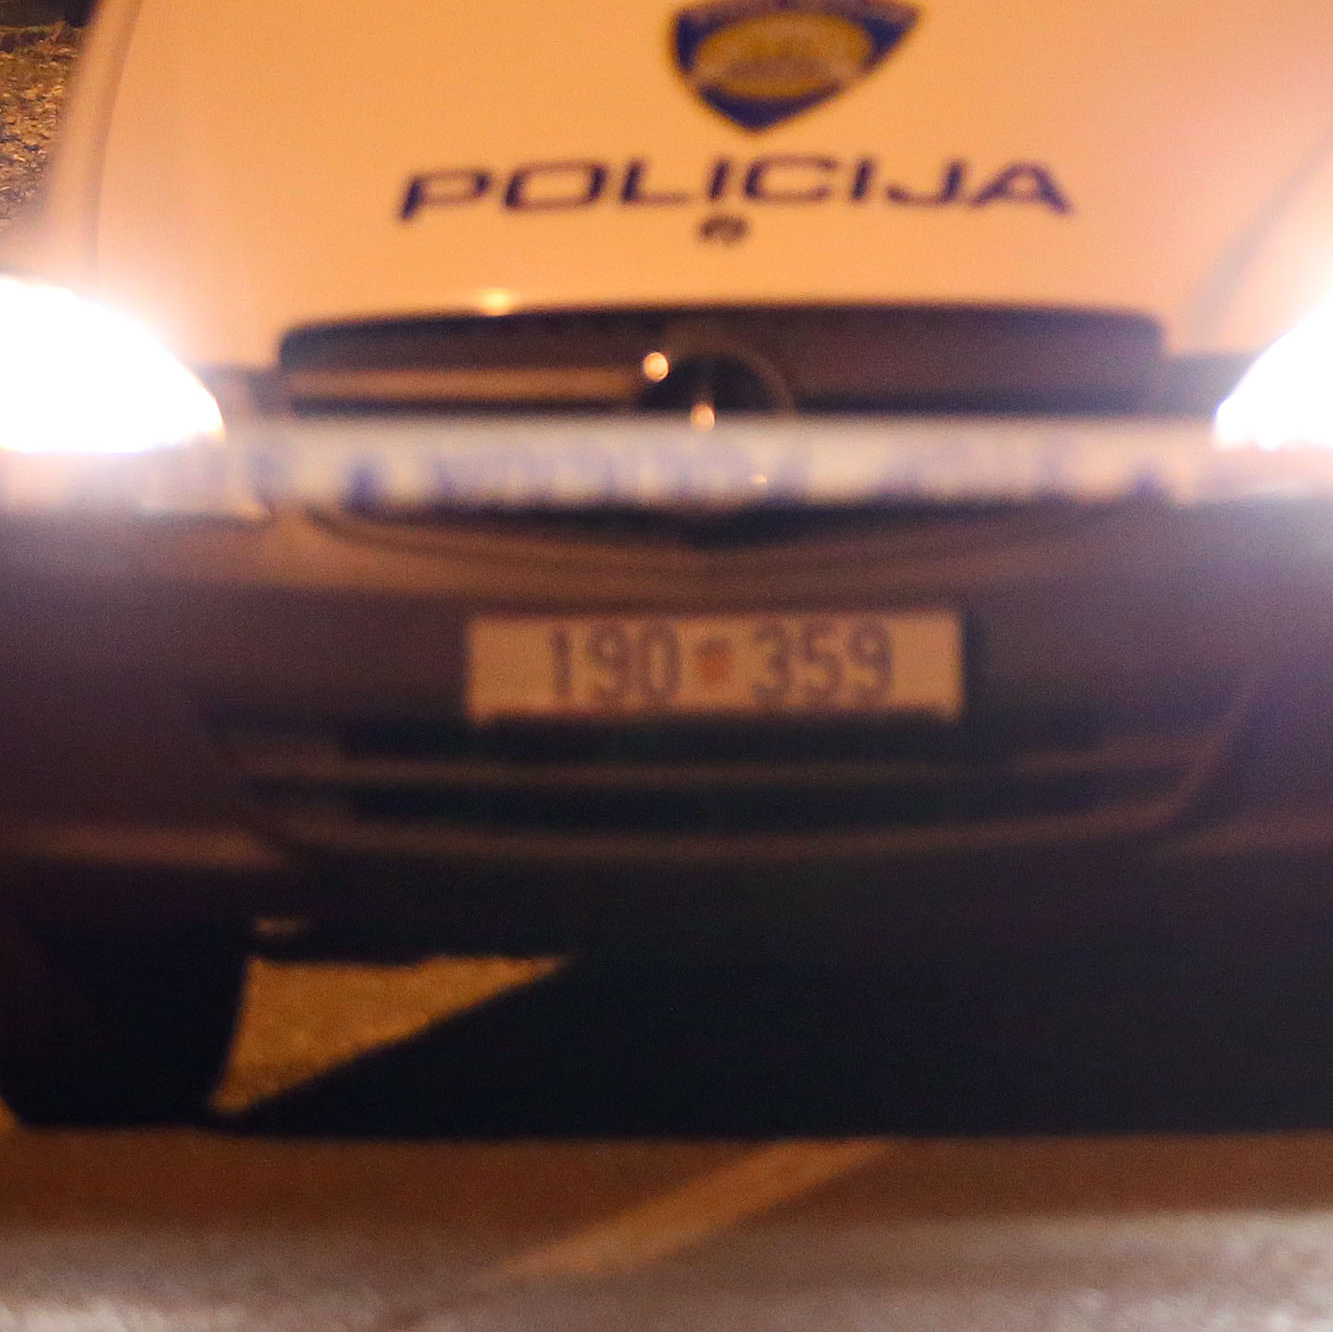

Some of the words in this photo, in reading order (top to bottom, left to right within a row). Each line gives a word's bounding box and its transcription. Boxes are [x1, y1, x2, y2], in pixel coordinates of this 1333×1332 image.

[396, 154, 1072, 222] POLICIJA
[552, 619, 681, 708] 190
[750, 619, 894, 708] 359
